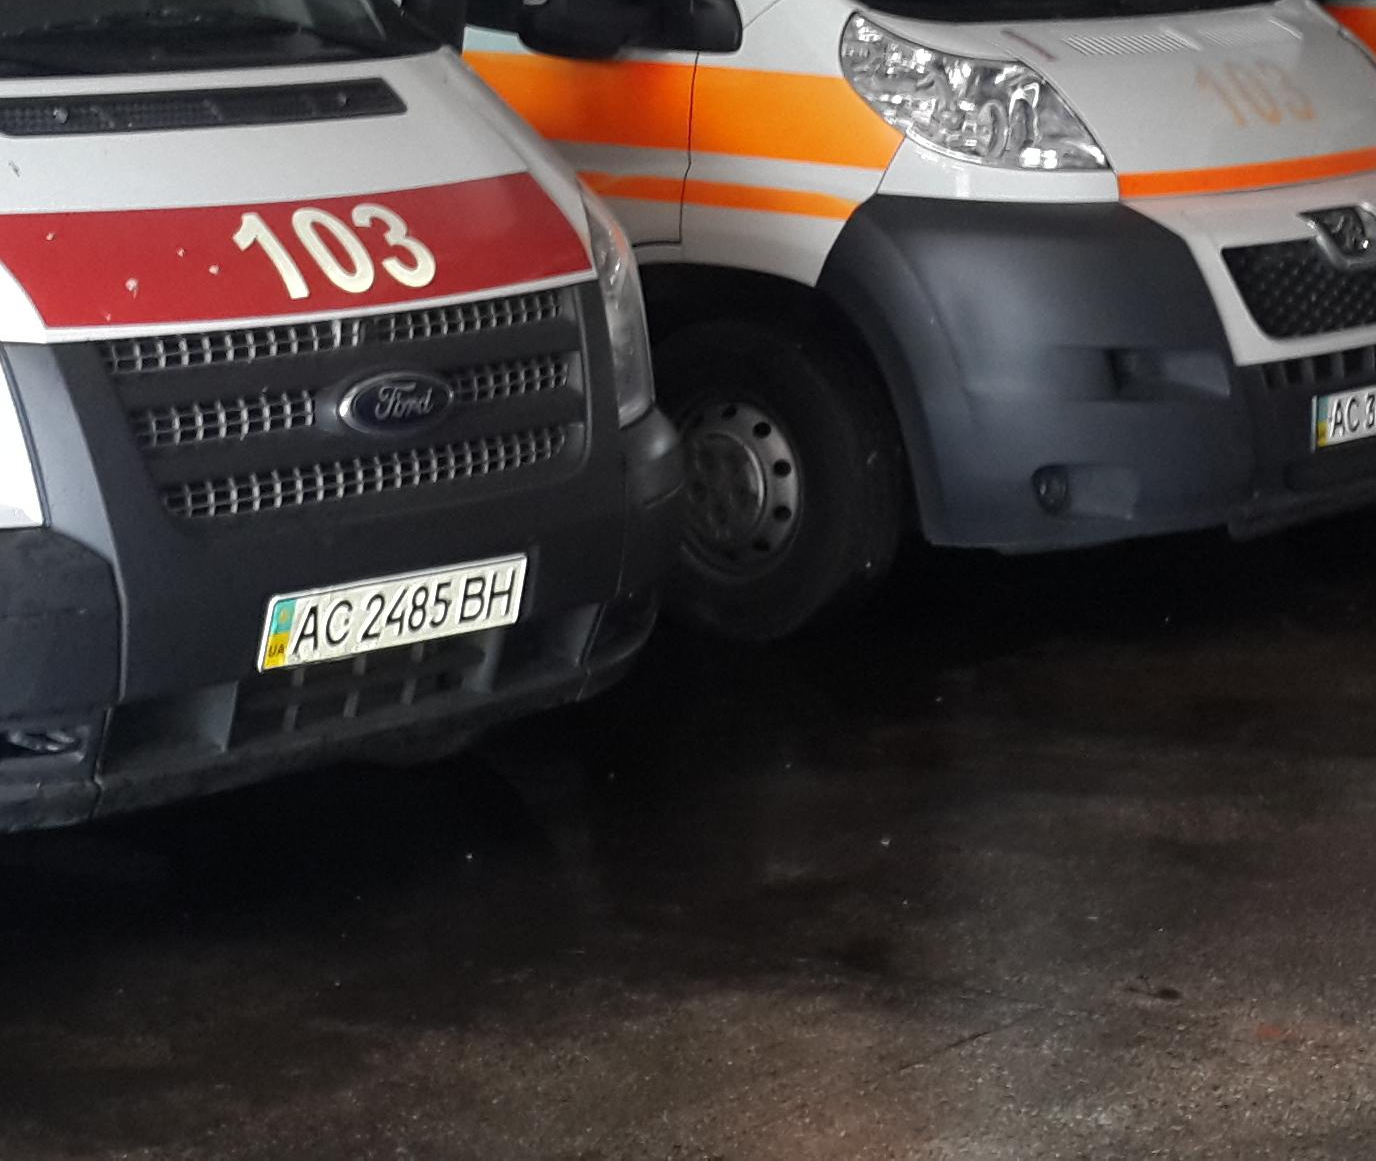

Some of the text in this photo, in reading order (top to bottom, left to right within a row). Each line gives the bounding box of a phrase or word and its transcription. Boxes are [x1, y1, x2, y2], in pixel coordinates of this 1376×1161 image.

[1197, 60, 1317, 128] 103
[232, 203, 436, 300] 103
[375, 382, 433, 419] Ford
[1330, 397, 1360, 437] AC
[293, 567, 516, 655] AC 2485 BH
